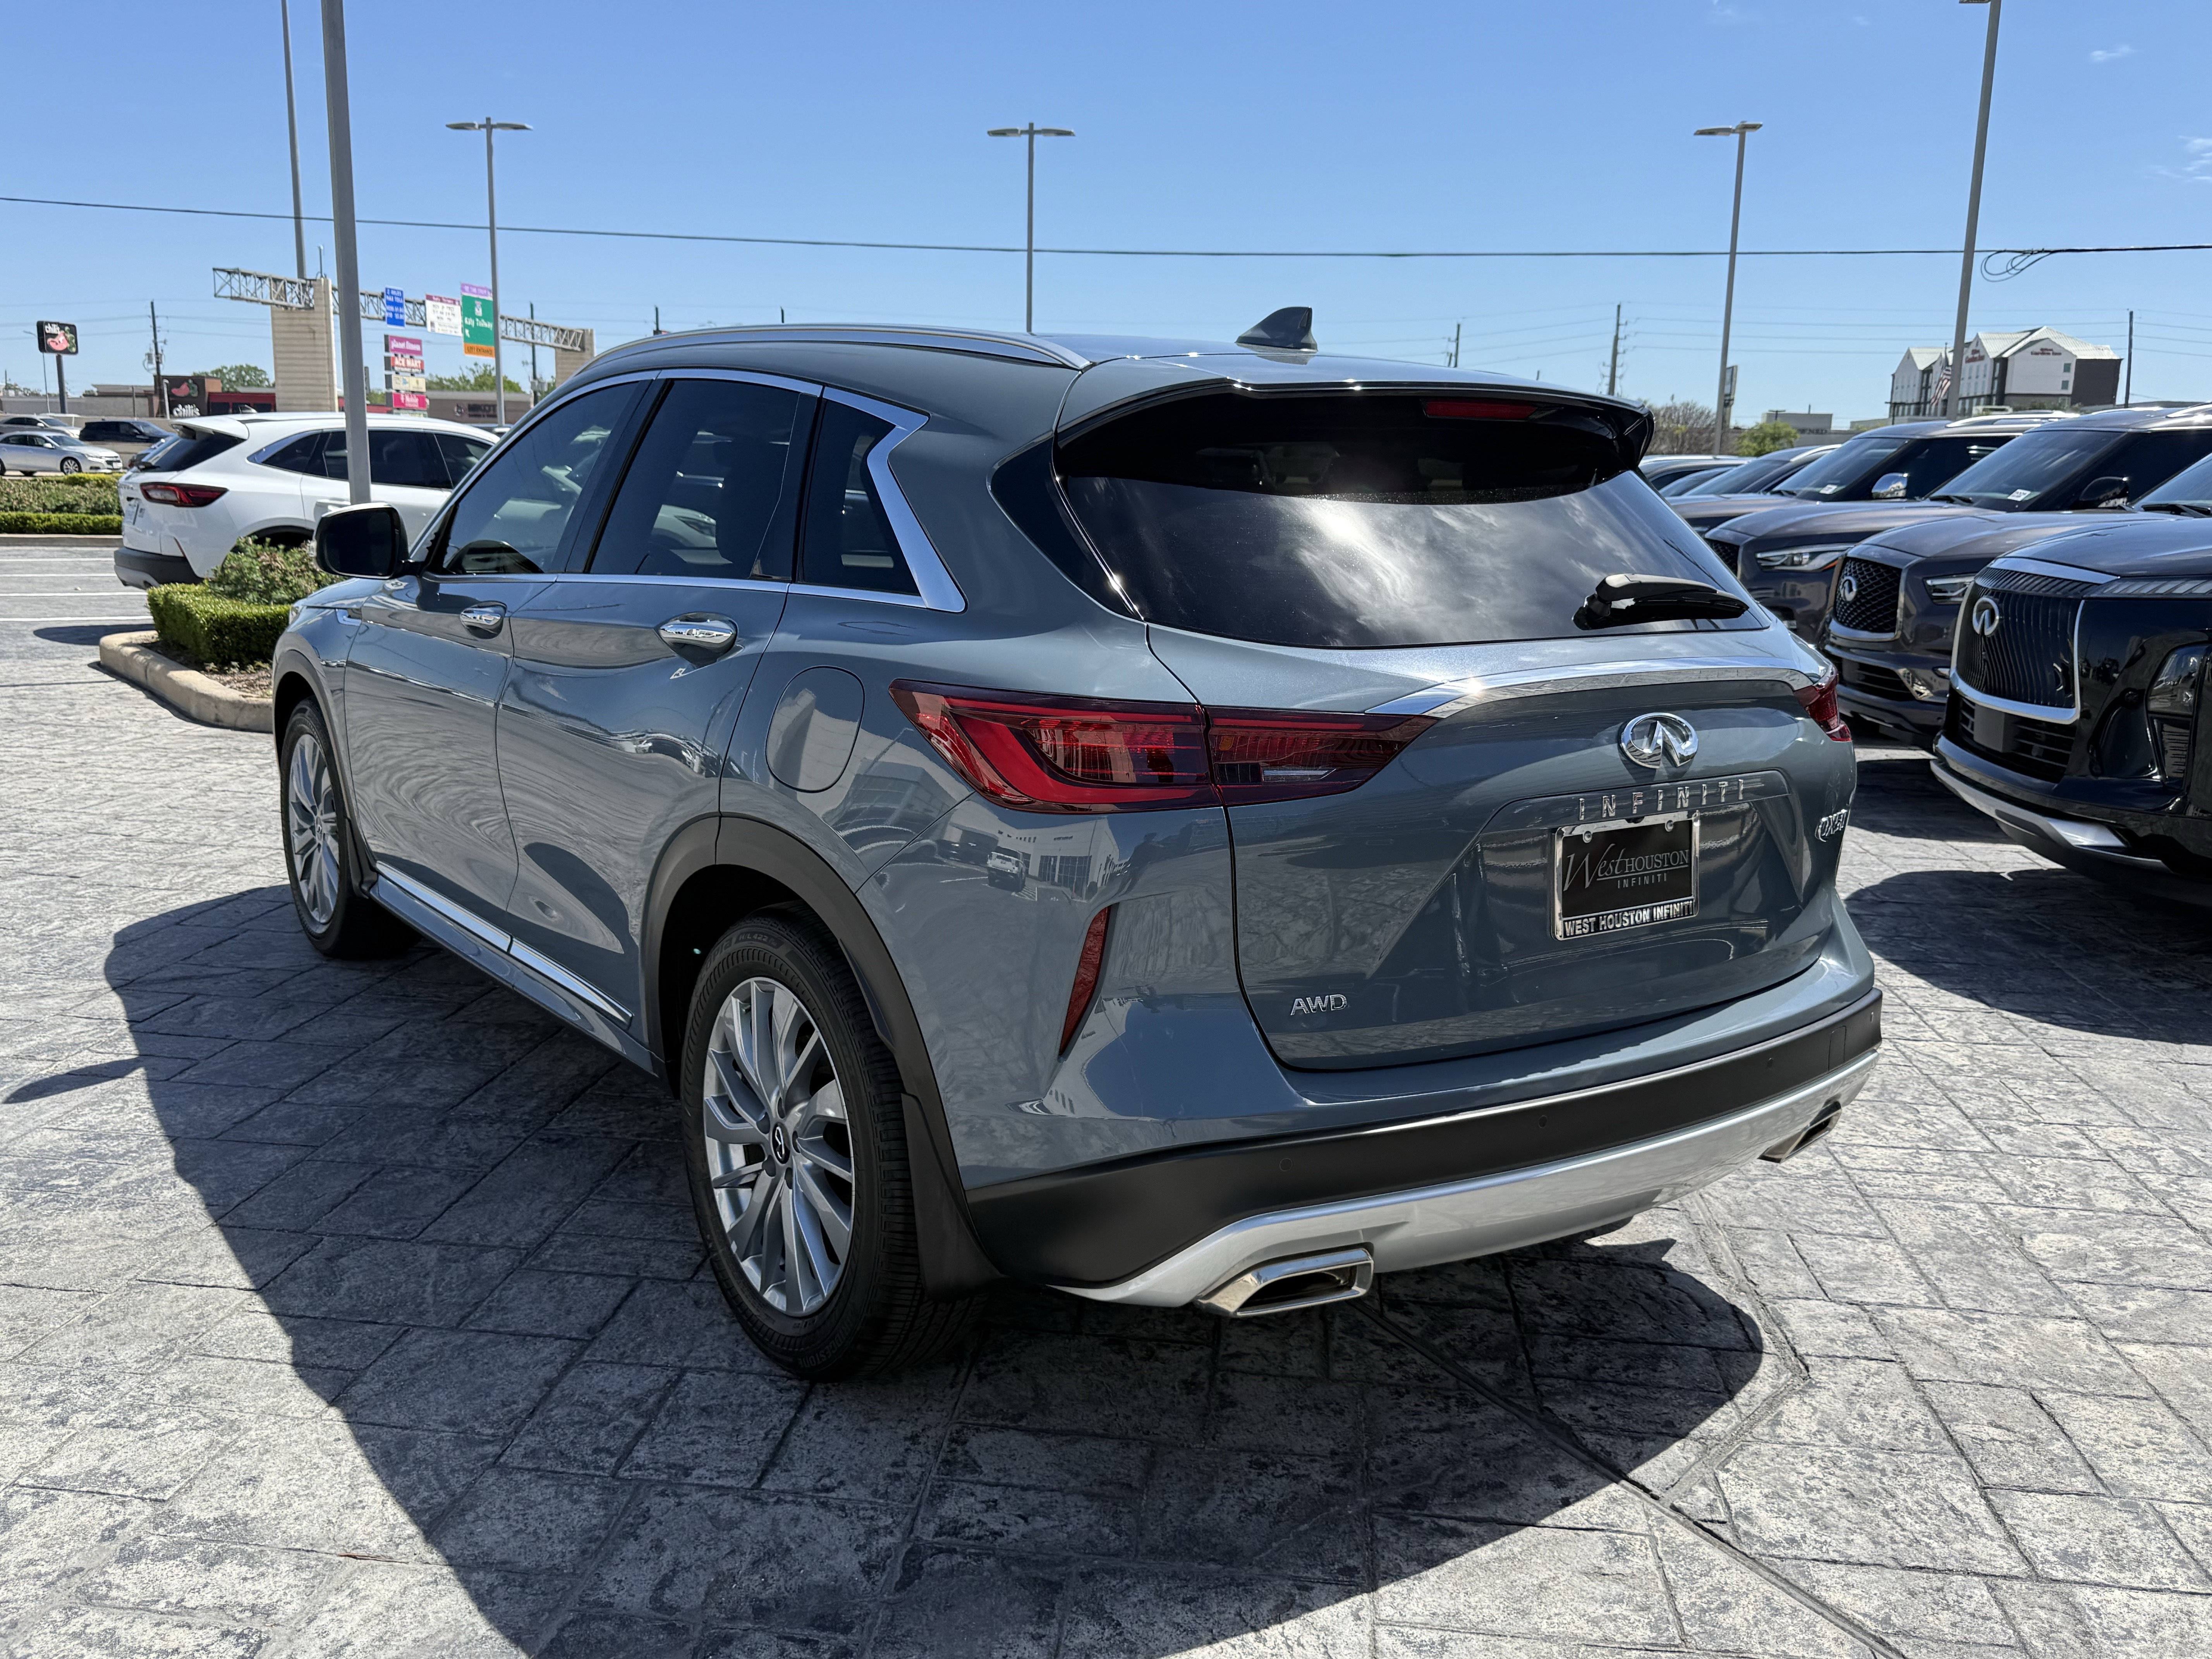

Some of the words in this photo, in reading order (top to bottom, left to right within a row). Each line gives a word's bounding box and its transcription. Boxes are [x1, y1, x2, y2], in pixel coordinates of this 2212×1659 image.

[173, 404, 201, 417] chili's
[1578, 779, 1744, 821] INFINITI
[1563, 843, 1626, 891] West
[1625, 849, 1690, 872] HOUSTON
[1618, 872, 1667, 889] INFINITI
[1565, 916, 1596, 936] WEST
[1599, 908, 1650, 931] HOUSTON
[1653, 900, 1693, 921] INFINITI
[1290, 994, 1347, 1016] AWD
